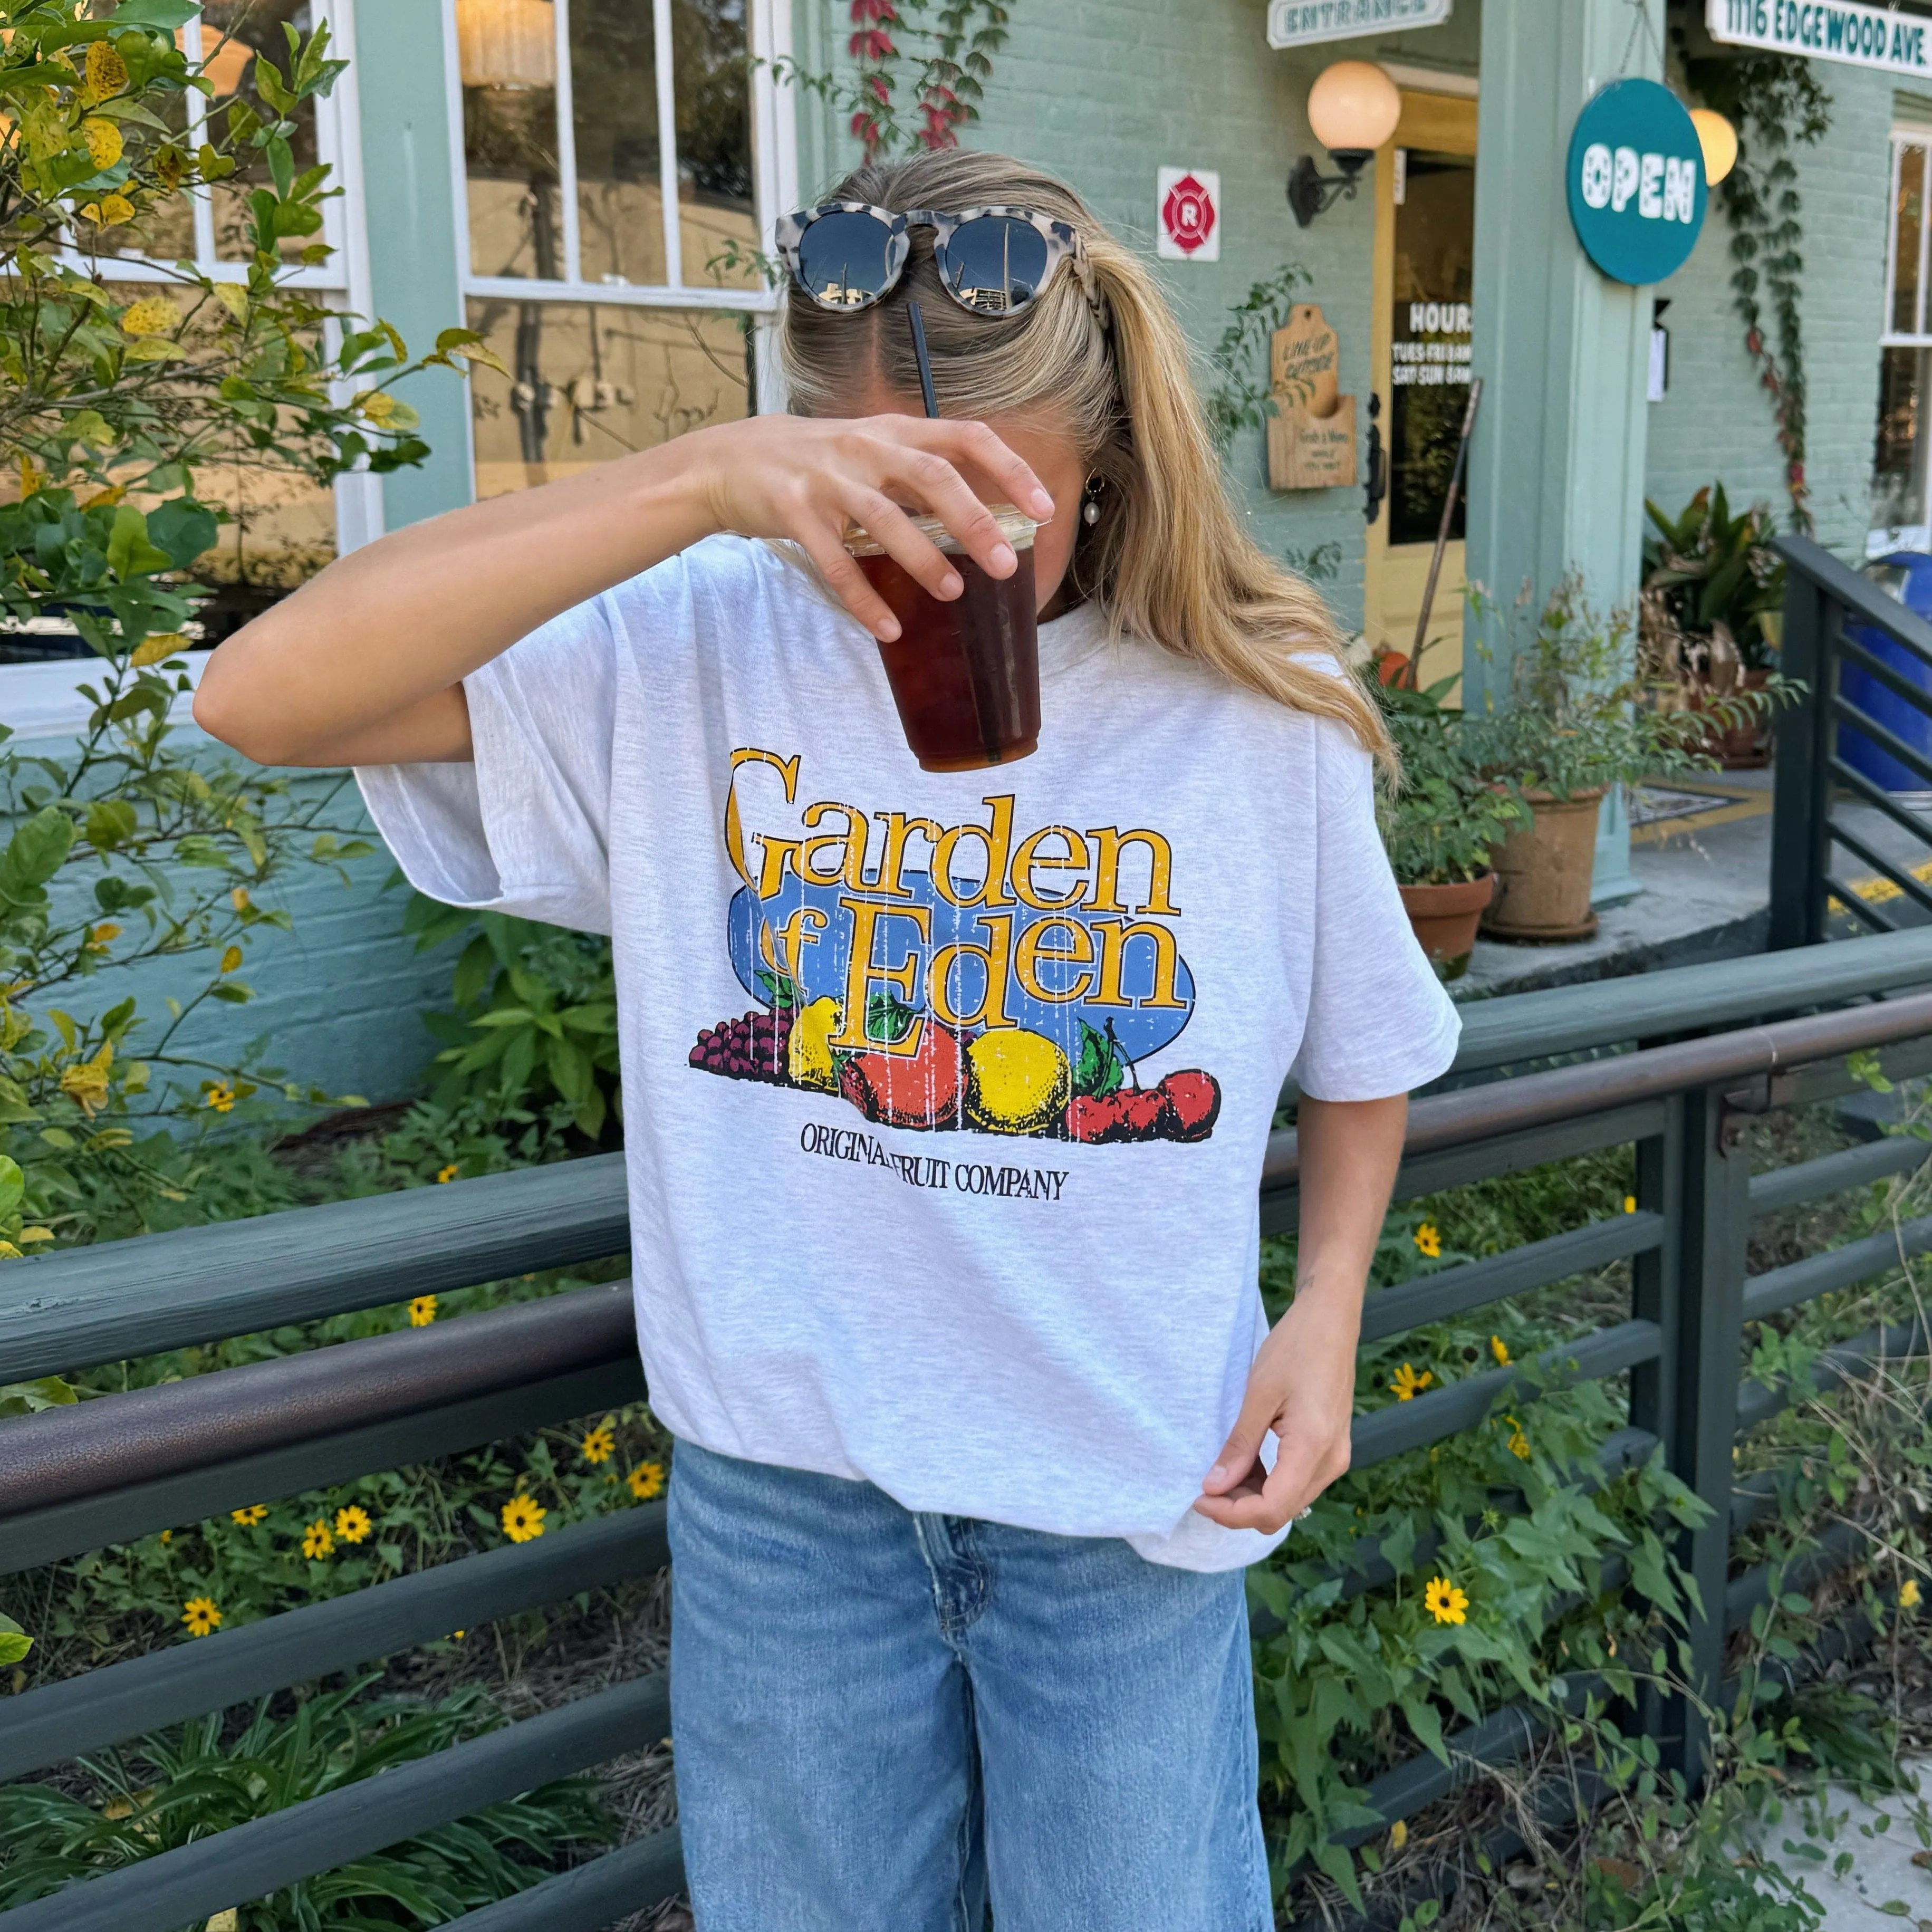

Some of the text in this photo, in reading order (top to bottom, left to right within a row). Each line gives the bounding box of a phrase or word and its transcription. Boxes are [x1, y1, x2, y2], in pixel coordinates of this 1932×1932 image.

[1726, 0, 1767, 37] 1116
[1774, 0, 1886, 57] EDGEWOOD
[1181, 202, 1198, 227] R
[1582, 142, 1697, 225] OPEN
[725, 747, 1183, 918] Garden
[828, 895, 1190, 1059] Eden
[801, 1122, 892, 1168] ORIGINA
[955, 1164, 1070, 1201] COMPANY
